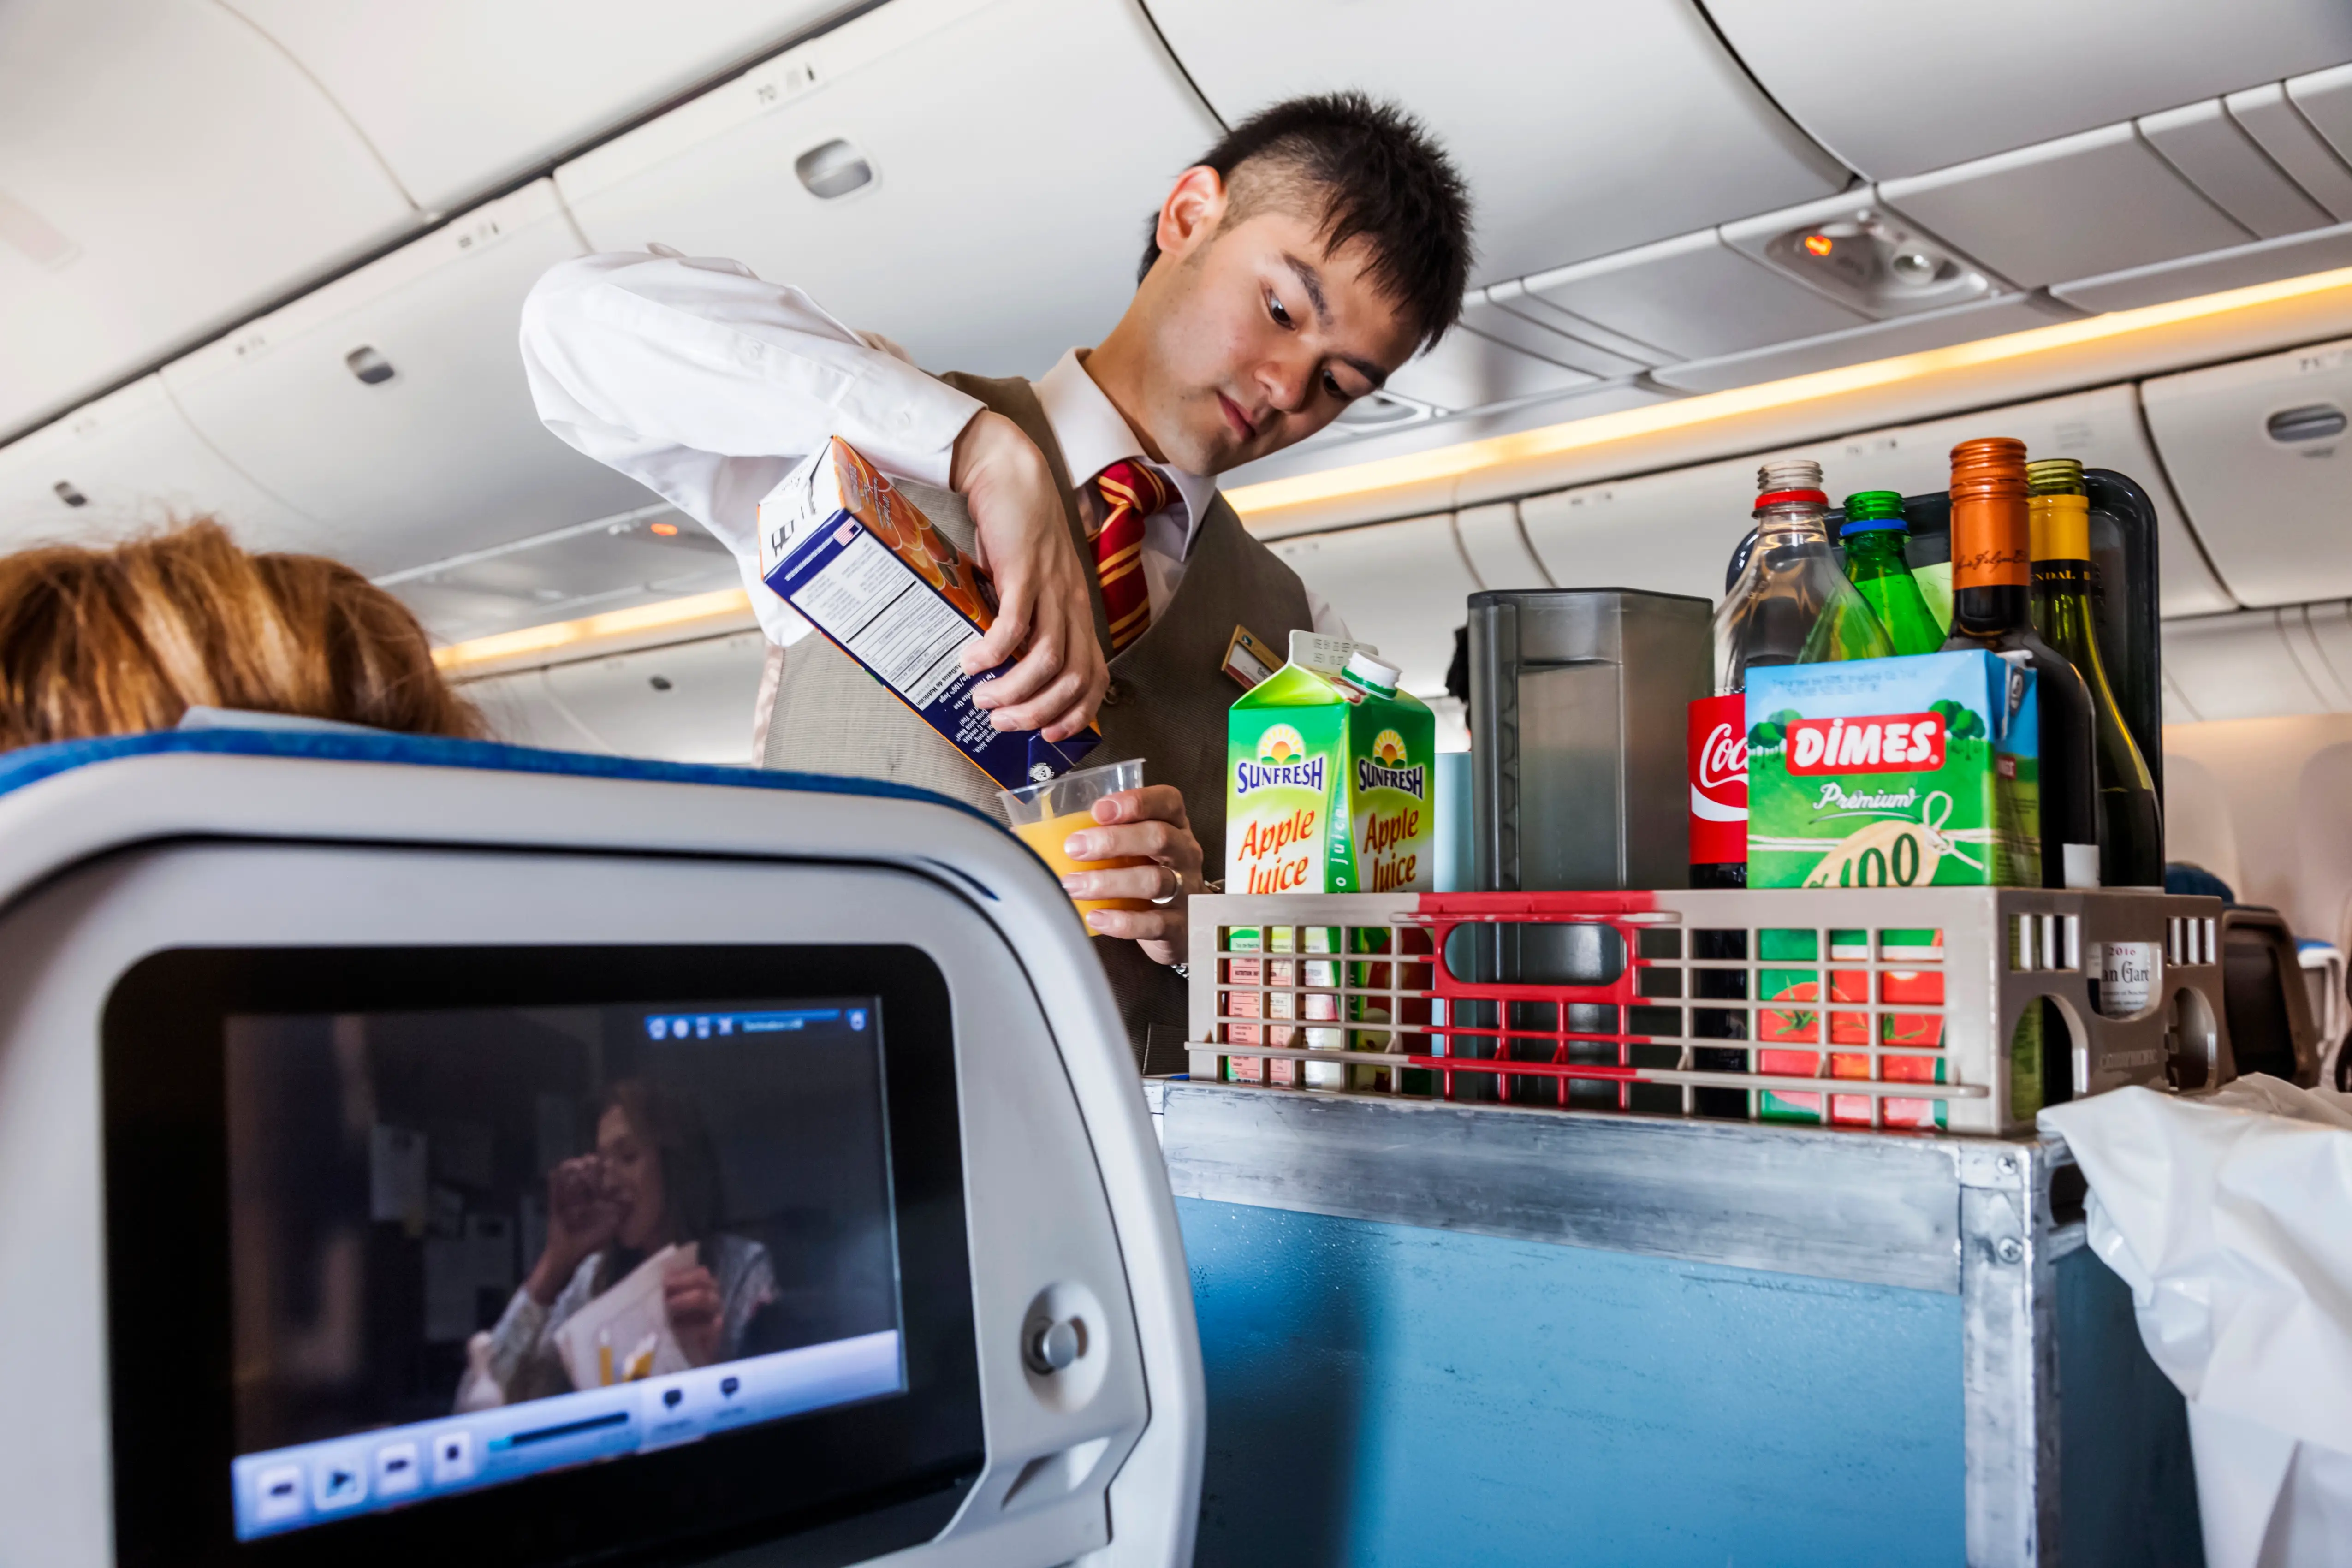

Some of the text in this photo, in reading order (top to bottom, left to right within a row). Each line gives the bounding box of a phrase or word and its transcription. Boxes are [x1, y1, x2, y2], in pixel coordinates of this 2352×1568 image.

[984, 671, 996, 682] For
[915, 686, 938, 707] Nutrición
[938, 691, 952, 704] Jugo
[951, 699, 965, 711] Use
[958, 714, 971, 727] You!
[967, 708, 976, 717] for
[974, 708, 989, 721] Drink
[964, 718, 979, 731] Juice
[962, 727, 980, 744] needed
[974, 728, 990, 742] strong
[971, 740, 989, 754] Juice,
[1237, 757, 1323, 794] SUNFRESH
[1359, 759, 1423, 801] SUNFRESH
[1812, 781, 1921, 810] Premium
[1238, 809, 1315, 861] Apple
[1330, 808, 1348, 865] juice
[1364, 807, 1420, 854] Apple
[1247, 855, 1309, 894] Juice
[1372, 852, 1416, 893] Juice
